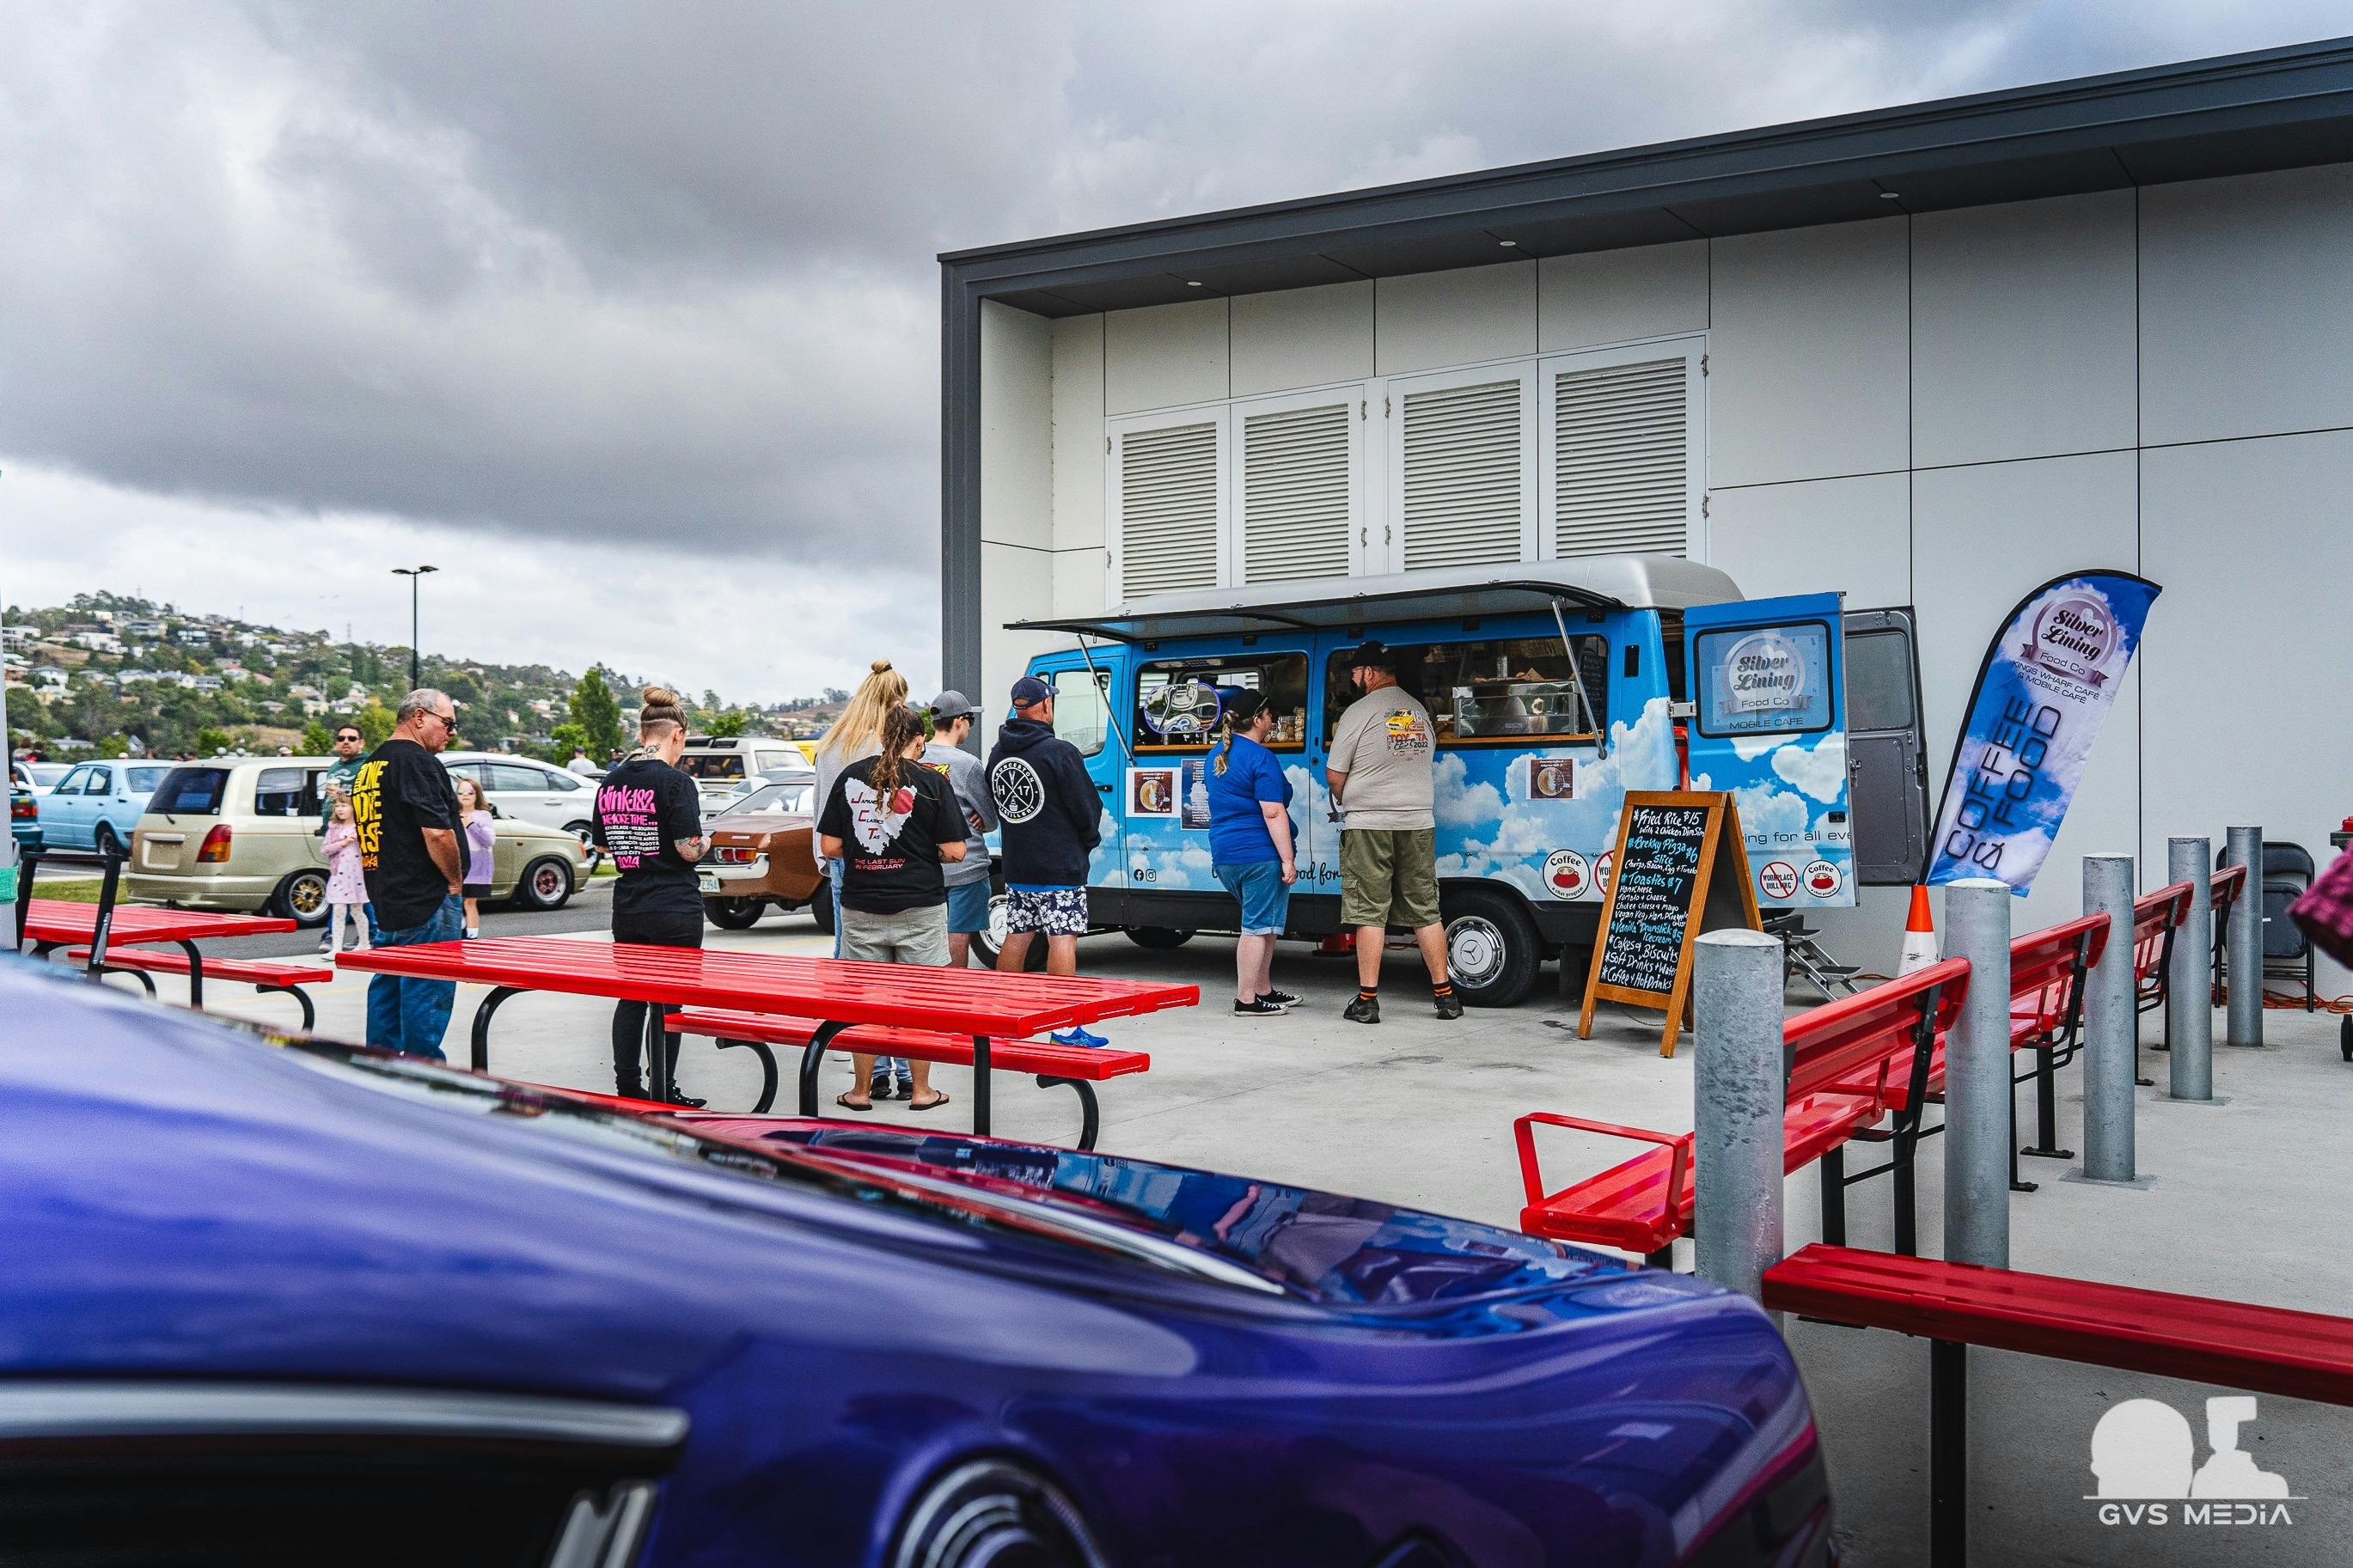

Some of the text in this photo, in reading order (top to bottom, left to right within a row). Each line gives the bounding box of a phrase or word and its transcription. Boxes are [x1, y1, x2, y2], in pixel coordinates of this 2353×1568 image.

[2053, 609, 2104, 638] Silver
[2041, 625, 2101, 662] Lining
[1737, 656, 1790, 673] Silver
[2039, 651, 2085, 675] Food Co
[1733, 672, 1796, 691] Lining
[2012, 660, 2100, 700] KINGS WHARF CAFÉ
[2026, 676, 2061, 693] MOBILE
[2062, 689, 2087, 705] CAFÉ
[1741, 698, 1769, 708] Food
[1729, 719, 1770, 729] MOBILE
[1945, 695, 2033, 859] COFFEE
[1972, 705, 2062, 870] & FOOD
[598, 785, 656, 815] blink-182
[1018, 785, 1030, 796] 17
[1637, 808, 1702, 827] Fried Rice $15
[1659, 826, 1682, 837] Chicken
[1774, 831, 1798, 842] for
[1805, 830, 1821, 841] all
[1635, 836, 1697, 863] Brekky Pizza $6
[1550, 856, 1581, 867] Coffee
[1808, 864, 1834, 874] Coffee
[1629, 871, 1665, 887] Toasties
[1667, 877, 1683, 894] $7
[1616, 921, 1636, 934] Vanilla
[1672, 928, 1684, 943] $5
[1613, 937, 1634, 952] Cakes
[1642, 944, 1678, 963] Biscuits
[1609, 951, 1626, 965] Soft
[1626, 955, 1653, 973] Drinks
[1659, 961, 1677, 976] Water
[1607, 966, 1630, 986] Coffee
